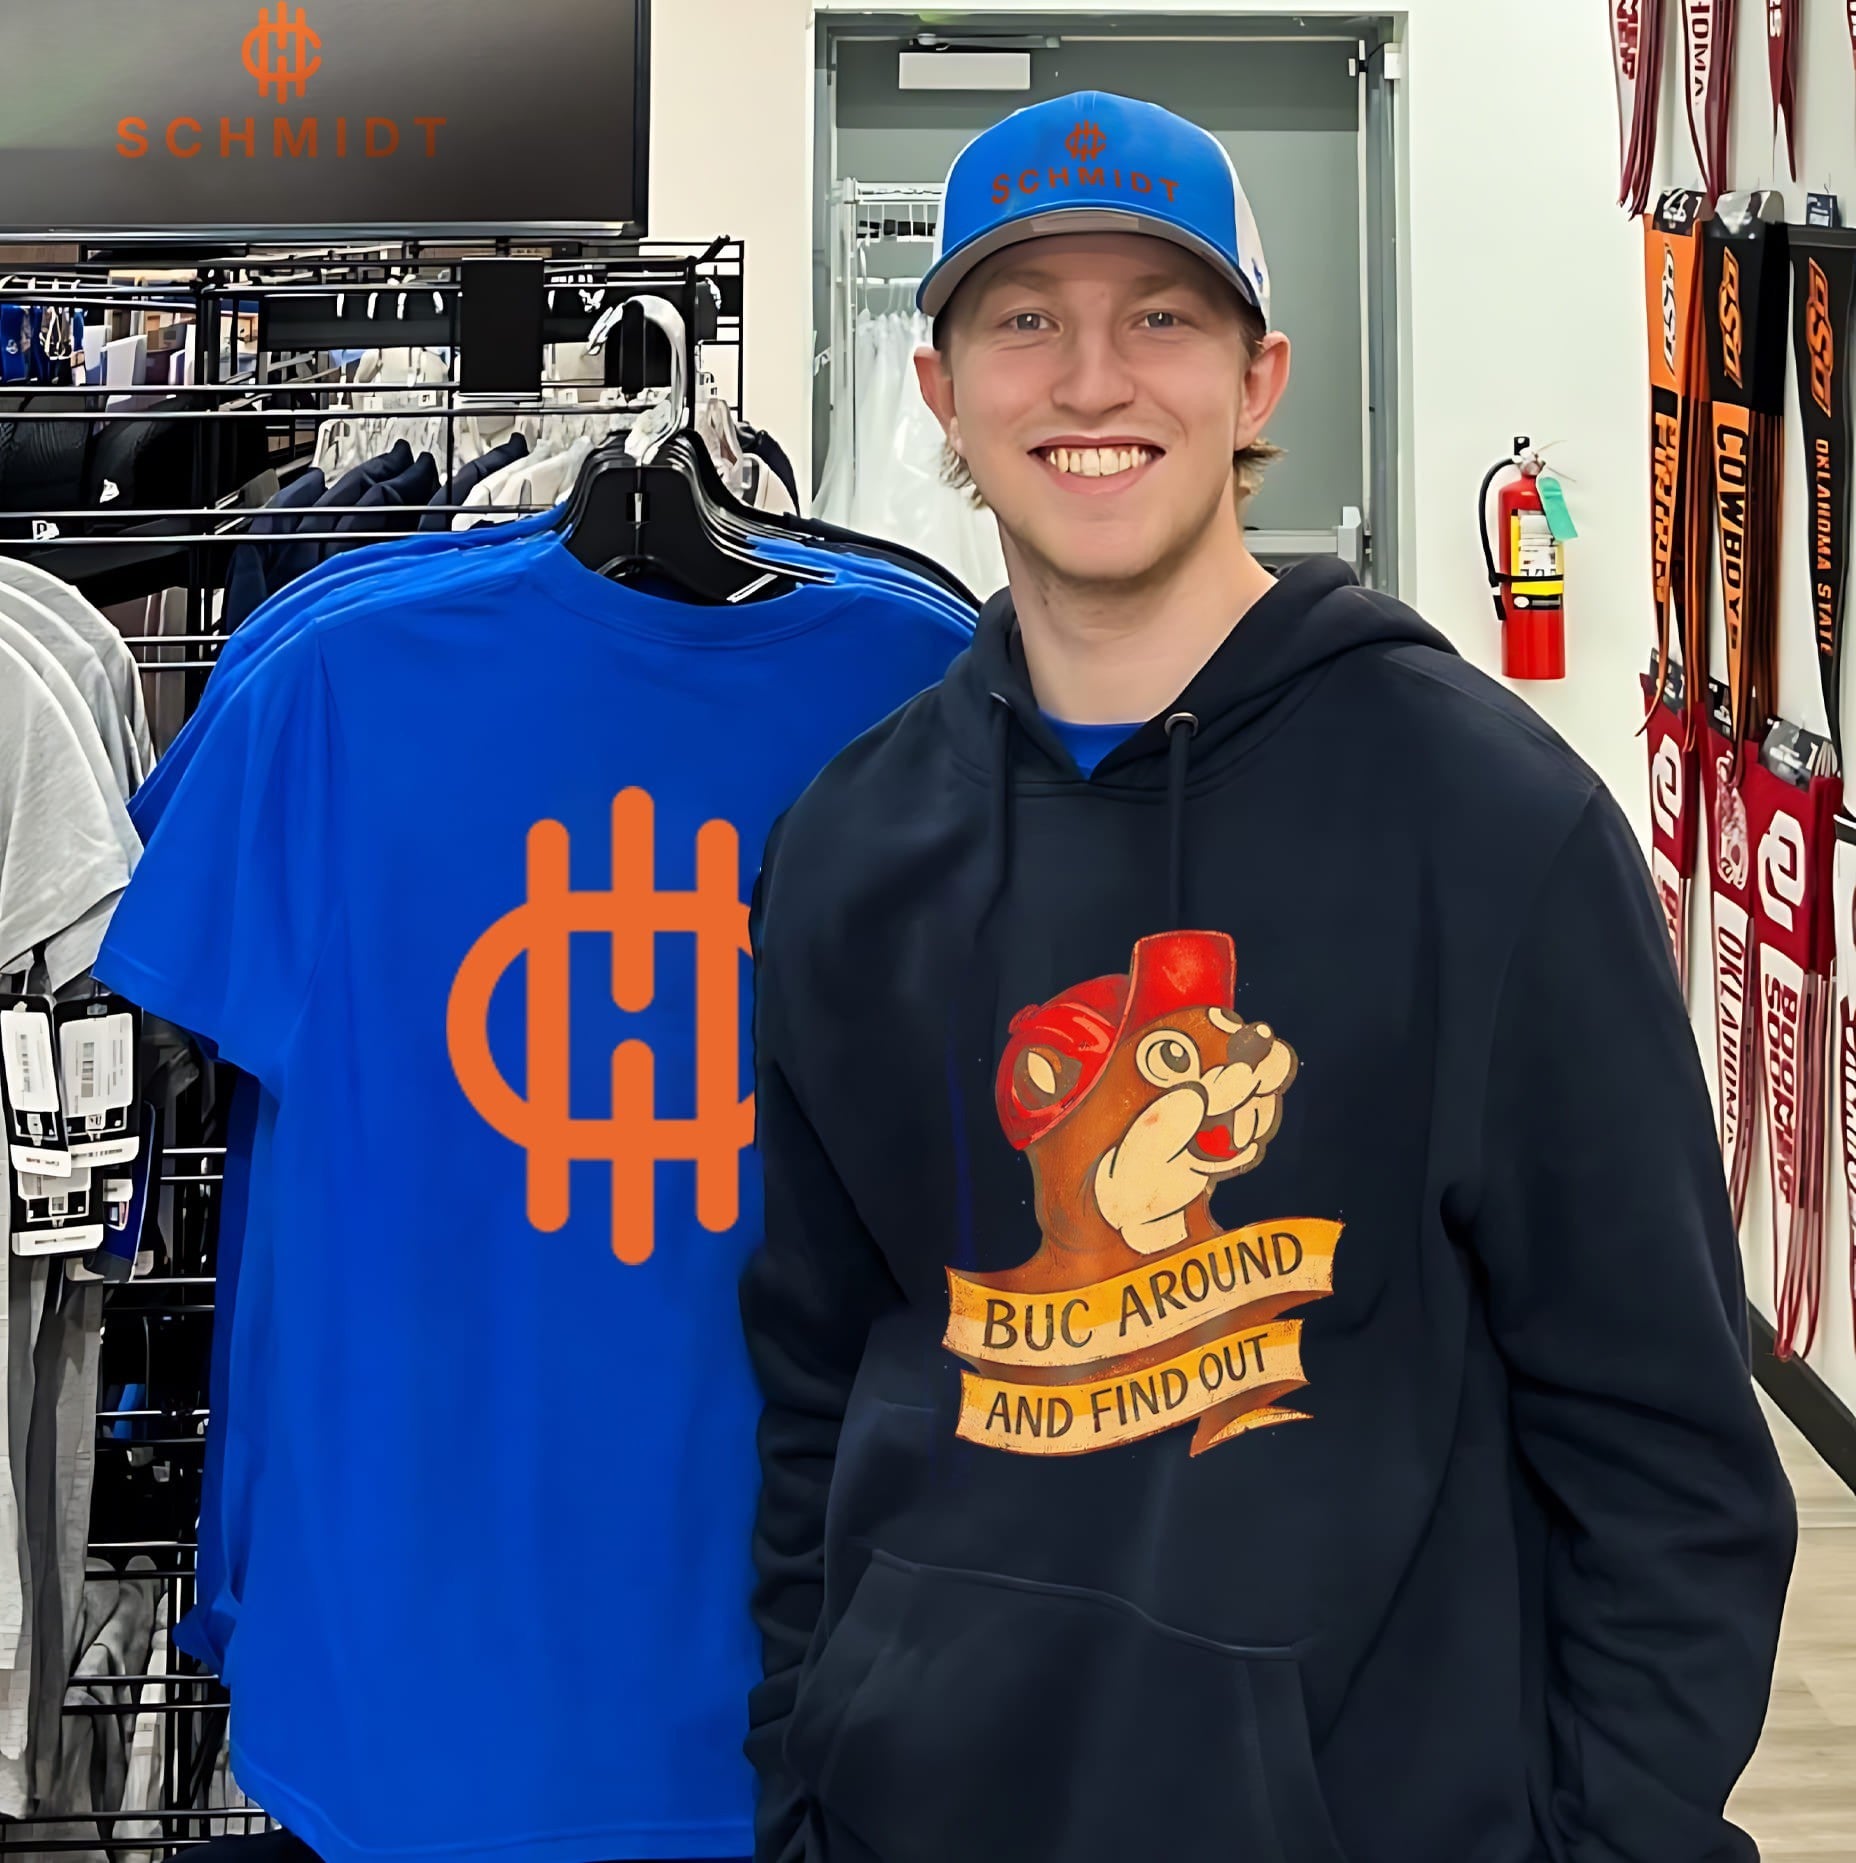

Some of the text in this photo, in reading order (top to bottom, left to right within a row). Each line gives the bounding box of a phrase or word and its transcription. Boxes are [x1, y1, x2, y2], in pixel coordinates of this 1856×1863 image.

[115, 116, 447, 159] SCHMIDT
[991, 166, 1179, 206] SCHMIDT
[1815, 438, 1833, 570] OKLAHOMA
[1718, 926, 1746, 1144] OKLAHOMA
[982, 1231, 1303, 1351] BUC AROUND
[985, 1332, 1269, 1439] AND FIND OUT
